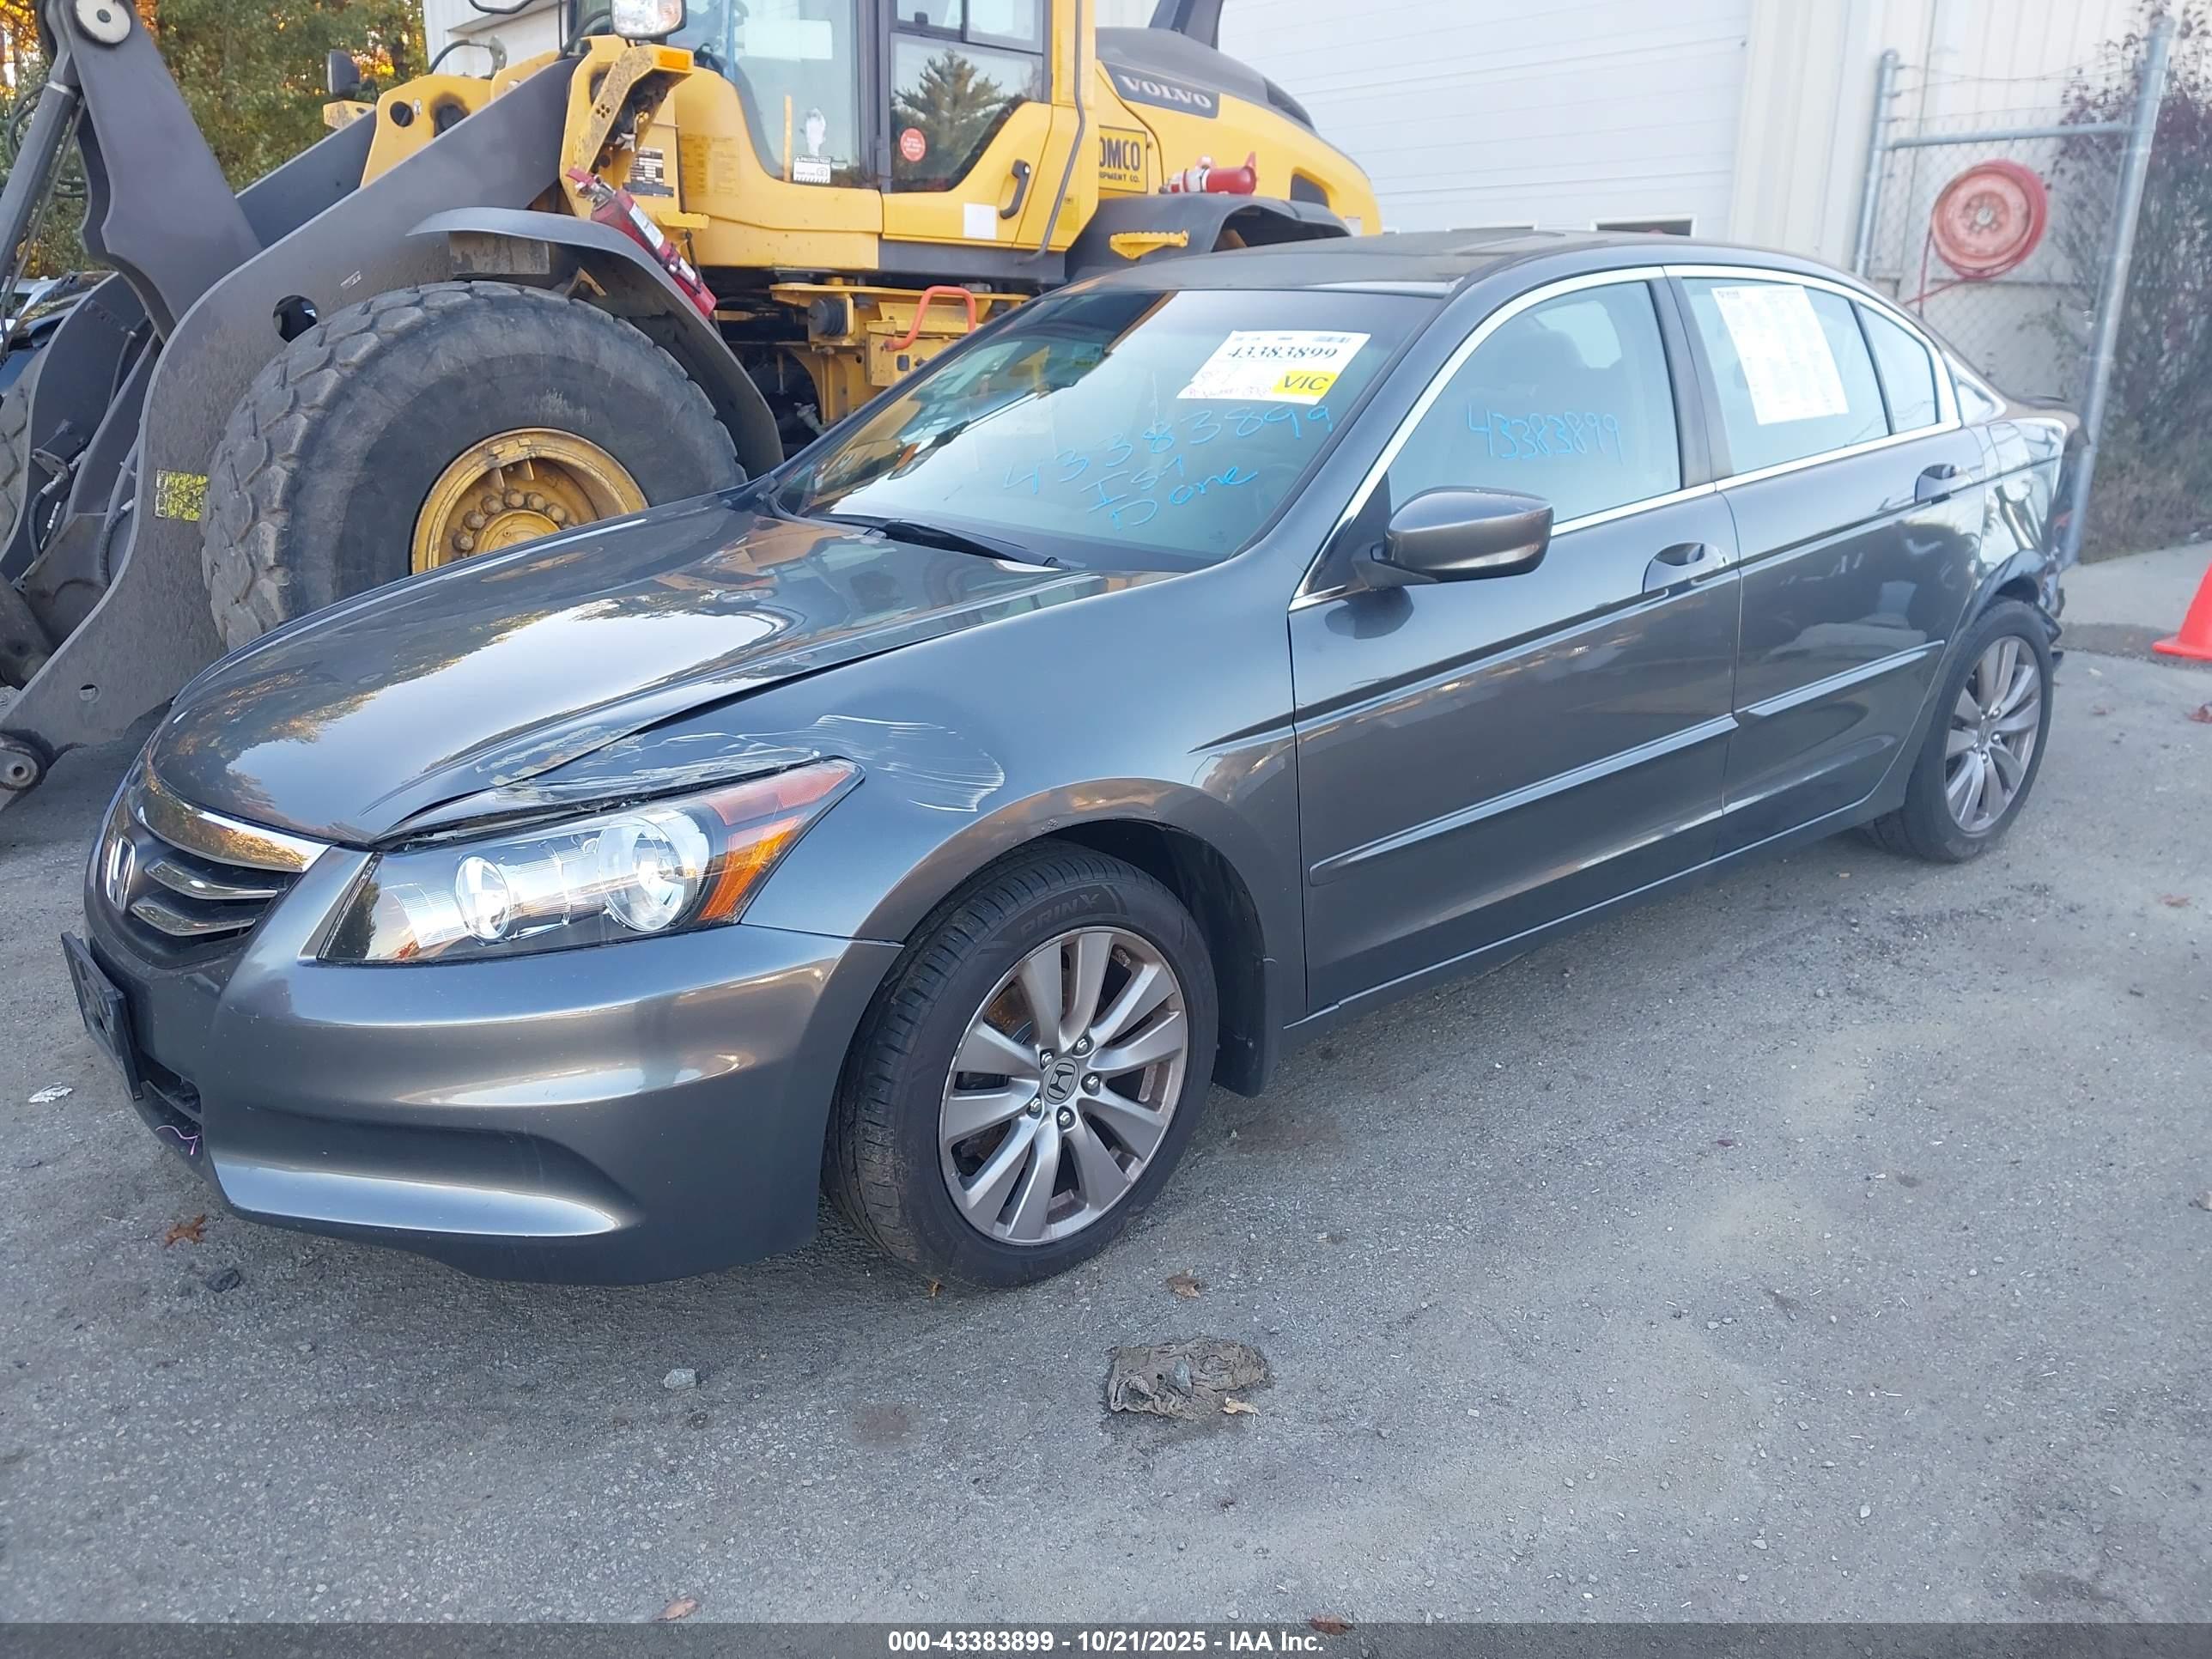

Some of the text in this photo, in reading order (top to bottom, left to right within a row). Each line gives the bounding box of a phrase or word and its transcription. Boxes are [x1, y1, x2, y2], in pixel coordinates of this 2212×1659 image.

[1118, 74, 1212, 109] VOLVO
[1228, 345, 1338, 359] 43383899
[1284, 375, 1329, 391] VIC
[1003, 404, 1334, 495] 43383899
[1467, 403, 1625, 466] 43383899
[1019, 893, 1100, 939] PRINX
